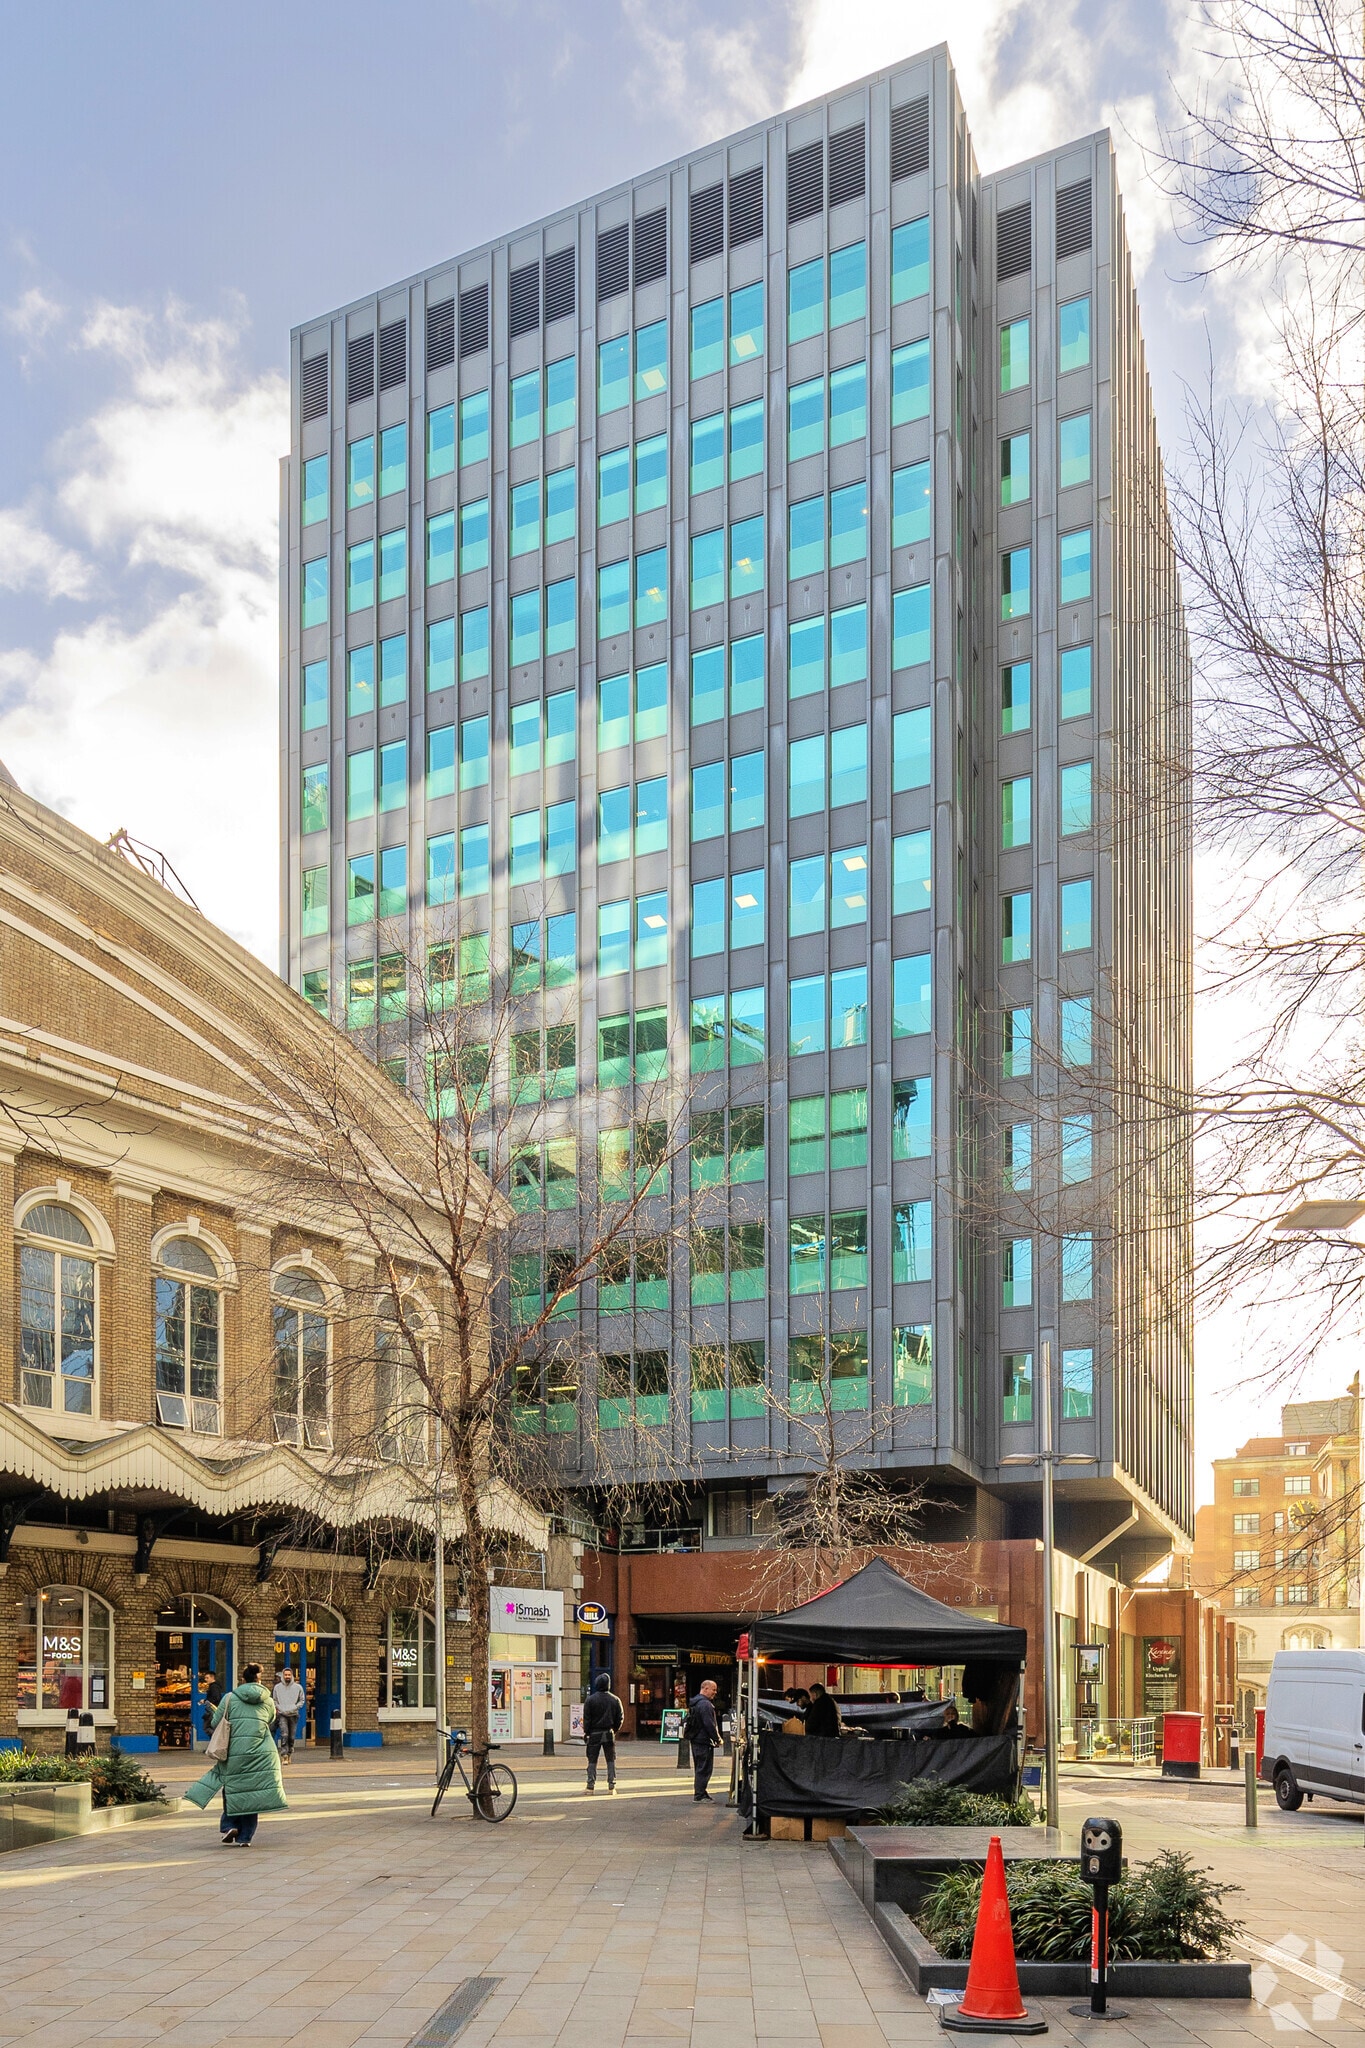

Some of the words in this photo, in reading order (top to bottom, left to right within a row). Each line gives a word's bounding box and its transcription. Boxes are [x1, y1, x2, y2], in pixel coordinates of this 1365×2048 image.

[515, 1603, 550, 1616] iSmash
[584, 1612, 598, 1620] HILL
[43, 1636, 81, 1651] M&S
[392, 1648, 417, 1660] M&S
[690, 1653, 704, 1664] THE
